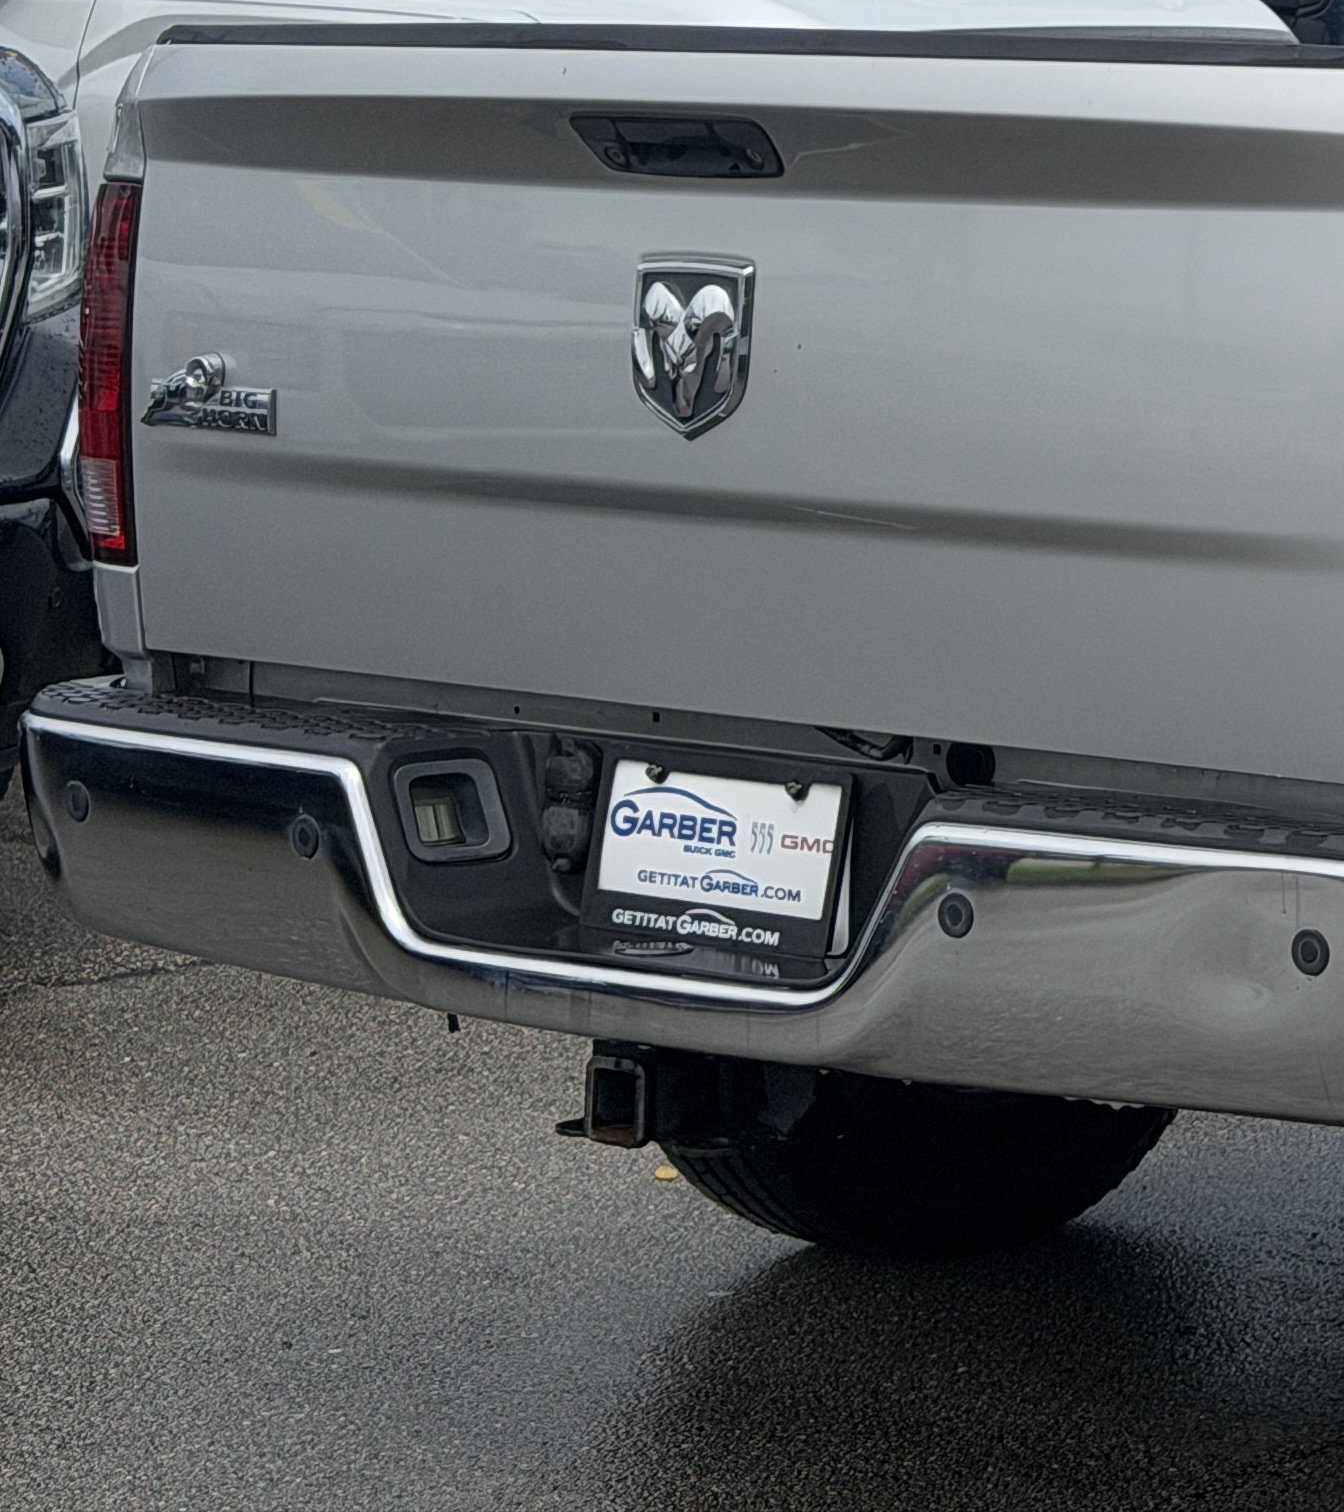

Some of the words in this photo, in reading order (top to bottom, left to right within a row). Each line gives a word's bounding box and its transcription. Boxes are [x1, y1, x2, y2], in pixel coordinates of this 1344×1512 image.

[219, 390, 258, 409] BIG
[199, 407, 267, 431] HORN
[610, 799, 738, 846] GARBER
